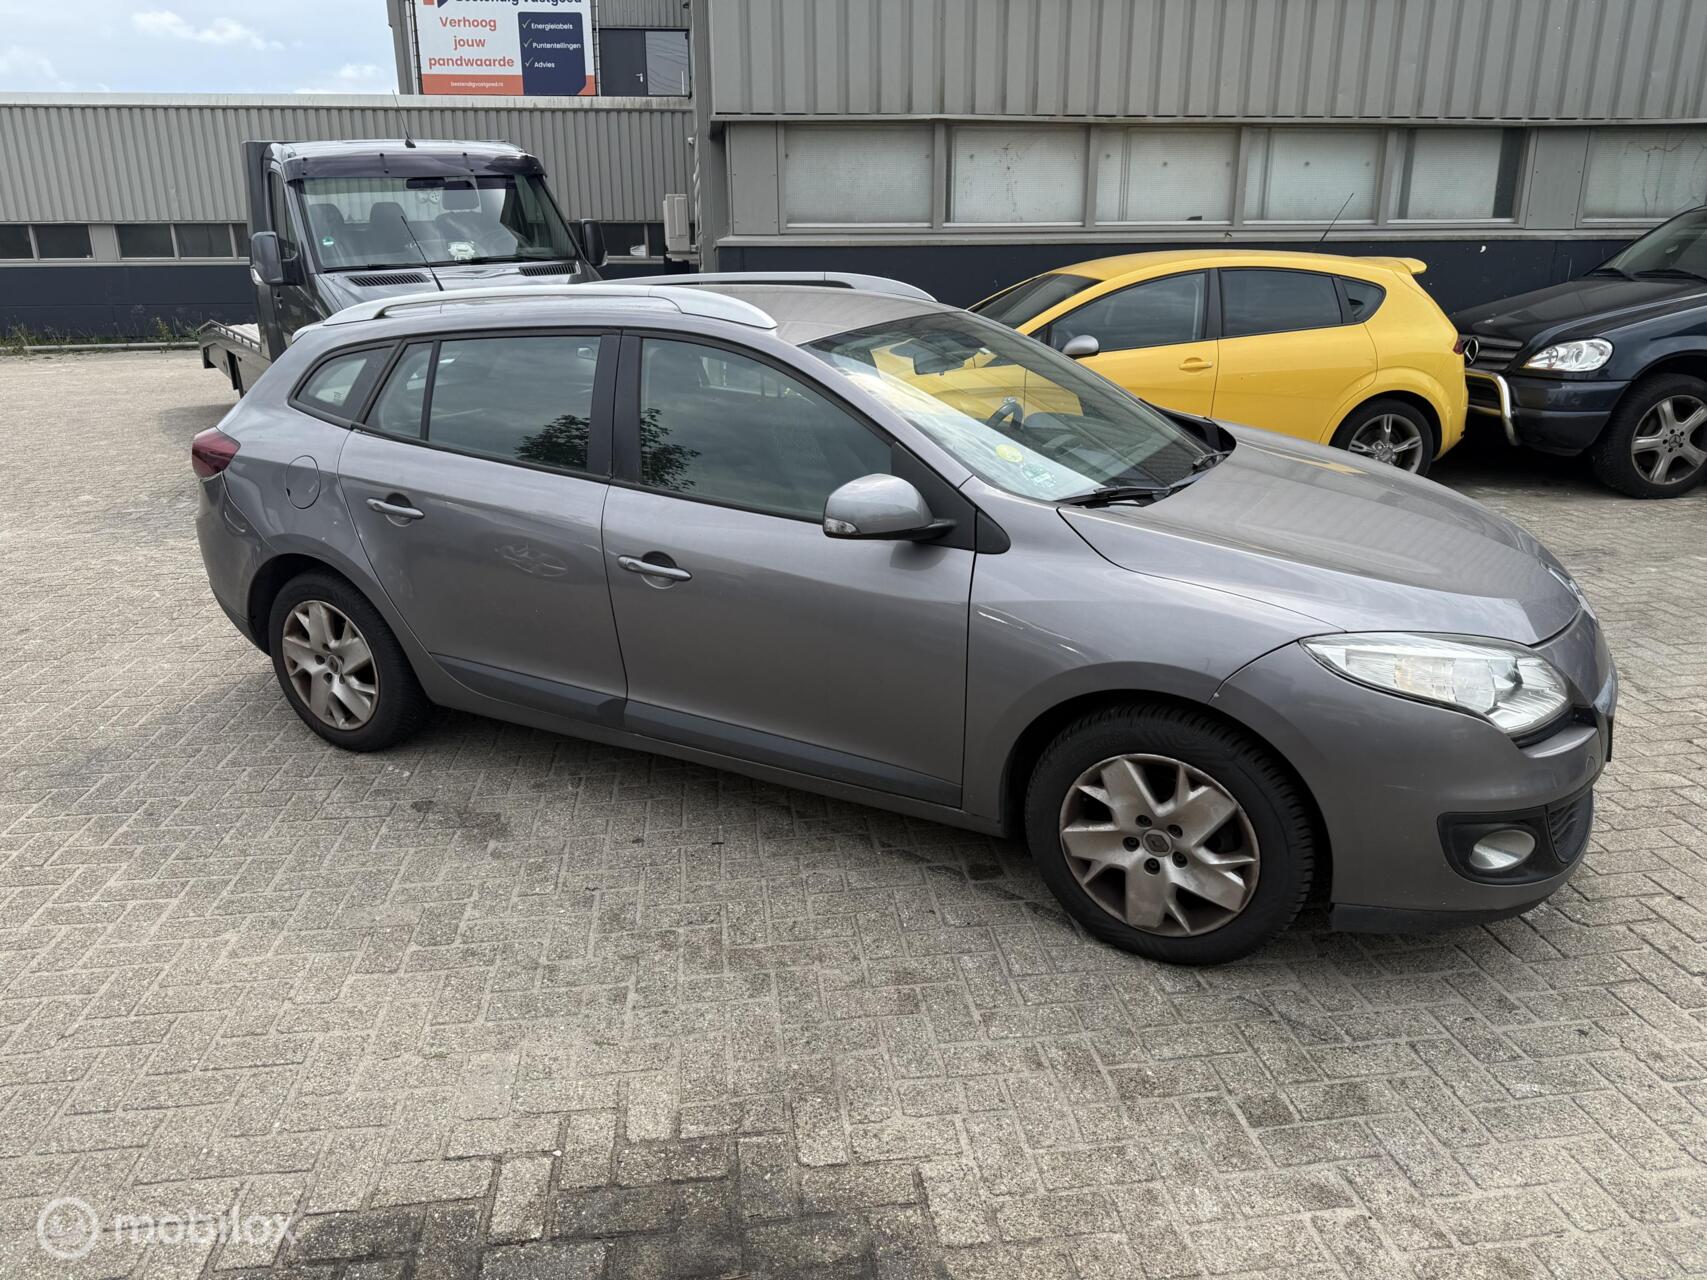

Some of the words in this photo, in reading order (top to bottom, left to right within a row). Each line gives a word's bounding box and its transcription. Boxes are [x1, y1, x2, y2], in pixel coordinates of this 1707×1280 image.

[439, 16, 497, 32] Verhoog
[531, 22, 573, 31] Energielabels
[453, 35, 486, 51] jouw
[532, 42, 582, 51] Puntentellingen
[428, 56, 514, 70] pandwaarde
[534, 61, 556, 69] Advies
